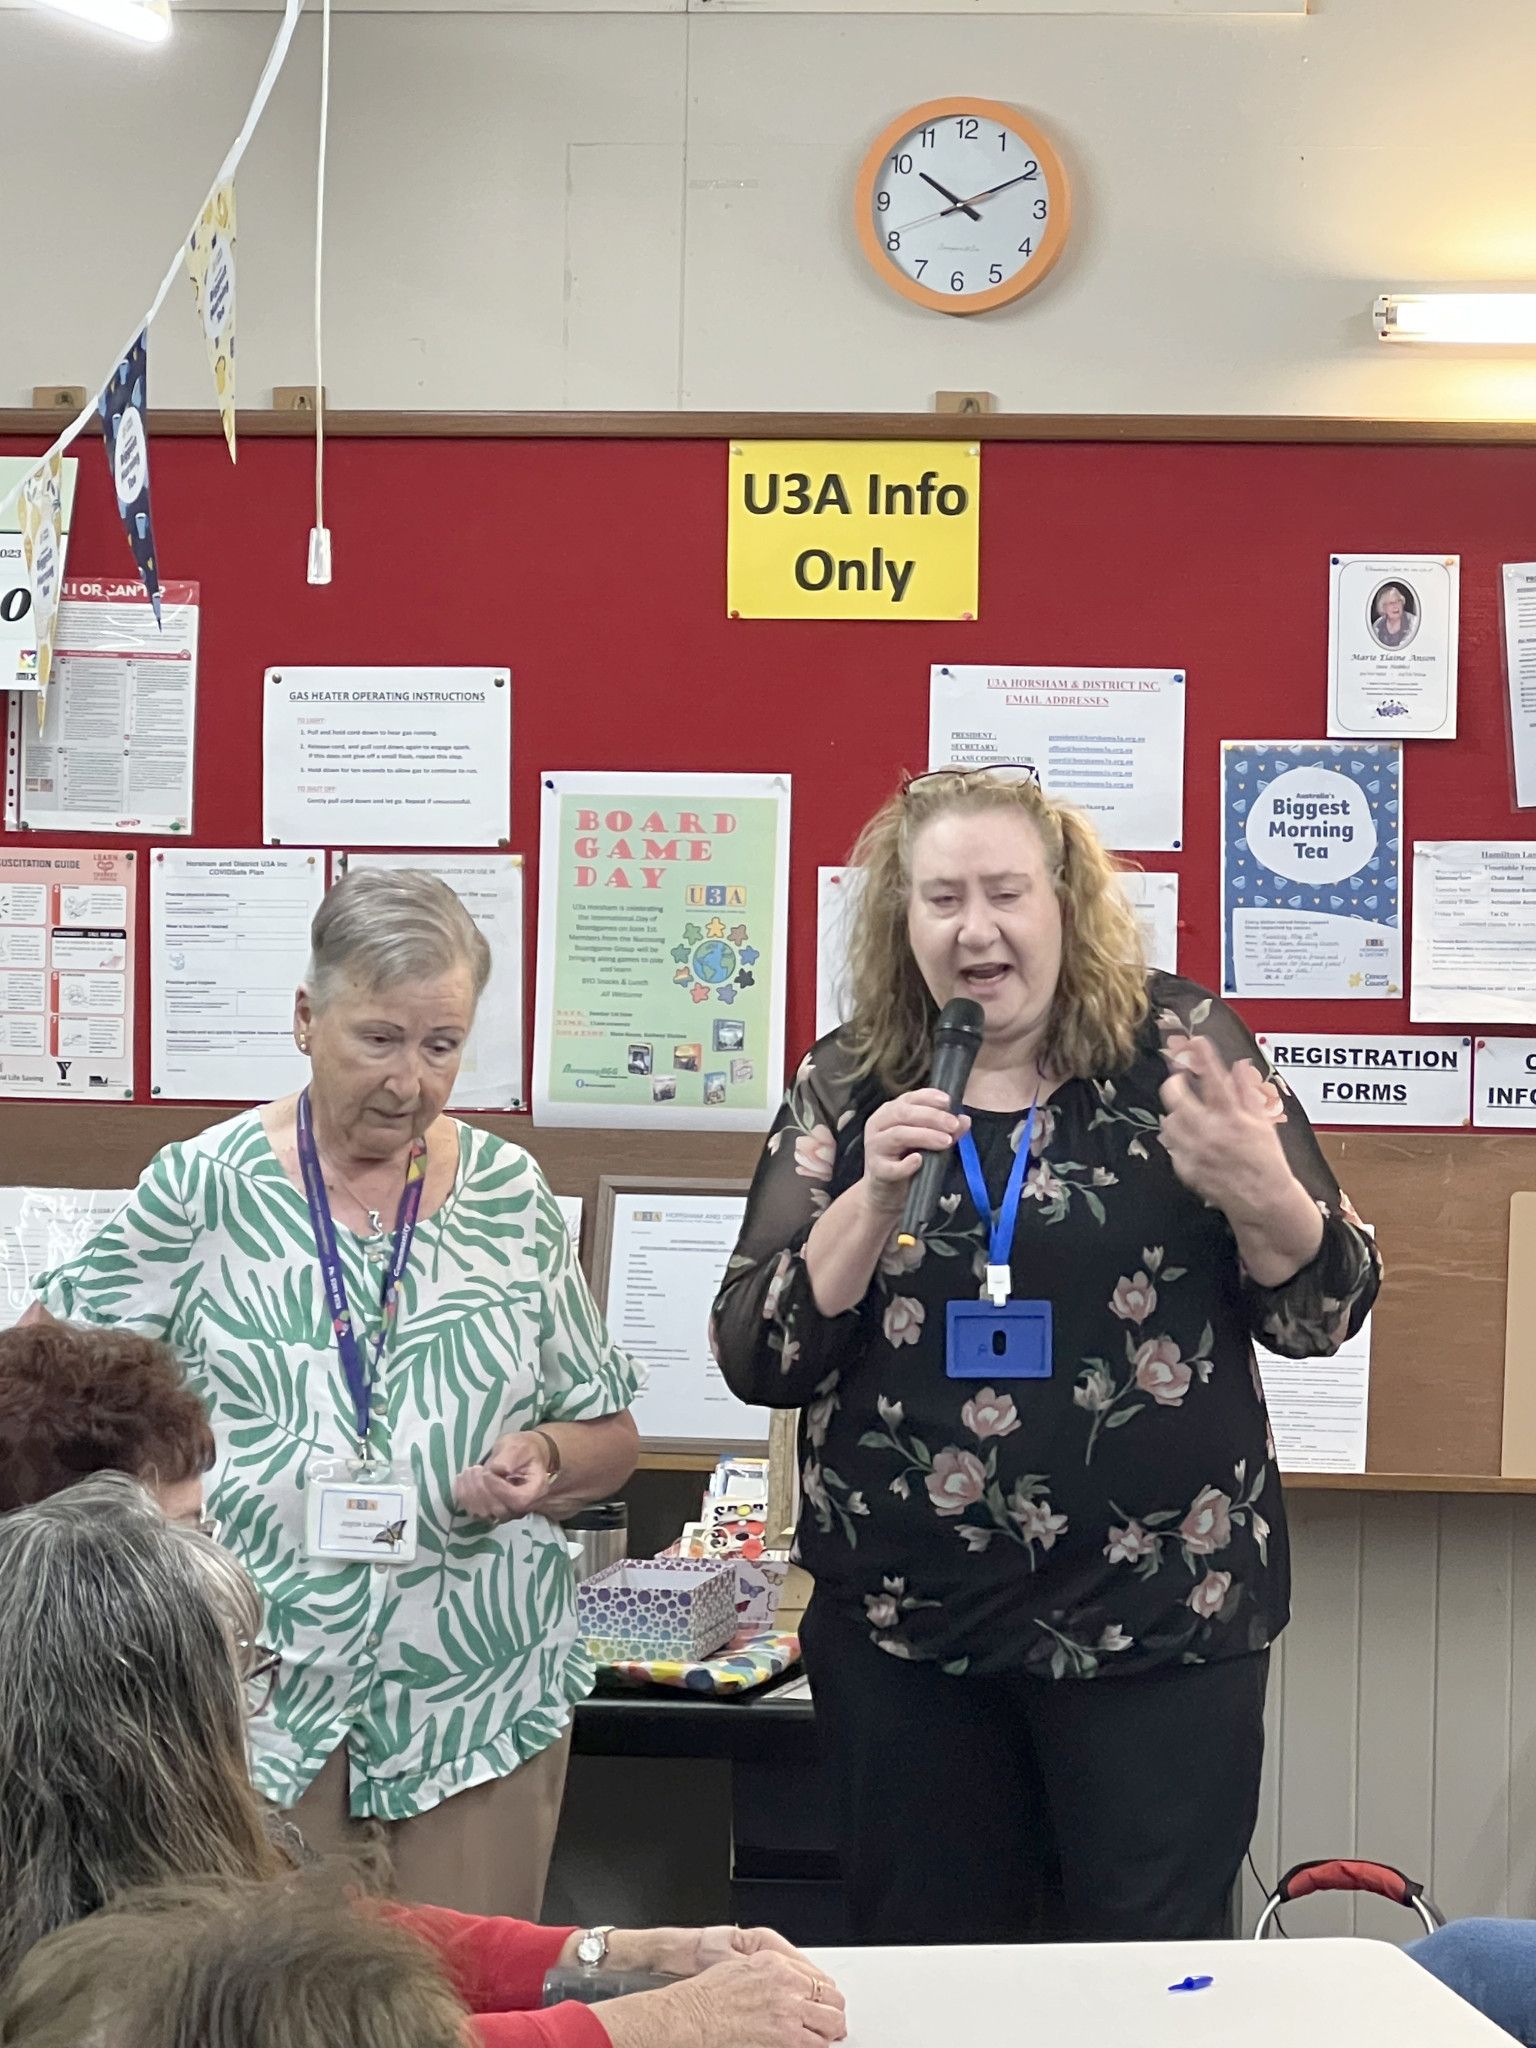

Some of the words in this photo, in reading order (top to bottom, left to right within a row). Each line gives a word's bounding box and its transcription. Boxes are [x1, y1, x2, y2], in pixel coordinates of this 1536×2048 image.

[918, 128, 936, 148] 11
[956, 119, 979, 139] 12
[998, 132, 1006, 152] 1
[891, 154, 913, 174] 10
[1023, 160, 1038, 181] 2
[877, 191, 890, 211] 9
[1033, 199, 1047, 219] 3
[887, 231, 900, 251] 8
[1017, 237, 1032, 257] 4
[915, 259, 928, 279] 7
[988, 264, 1003, 284] 5
[950, 271, 964, 291] 6
[744, 472, 852, 515] U3A
[868, 471, 968, 516] Info
[795, 547, 916, 602] Only
[80, 584, 103, 597] OR
[987, 678, 1008, 688] U3A
[1011, 679, 1068, 689] HORSHAM
[1071, 679, 1080, 689] &
[1082, 680, 1136, 690] DISTRICT
[1138, 681, 1161, 691] INC.
[289, 691, 309, 701] GAS
[311, 691, 350, 701] HEATER
[352, 691, 410, 701] OPERATING
[412, 692, 485, 702] INSTRUCTIONS
[1006, 695, 1040, 705] EMAIL
[1046, 696, 1109, 706] ADDRESSES
[1295, 792, 1336, 800] Australia's
[1273, 797, 1351, 820] Biggest
[574, 809, 737, 834] BOARD
[1269, 821, 1354, 843] Morning
[573, 836, 713, 862] GAME
[1293, 842, 1329, 859] Tea
[1481, 851, 1520, 859] Hamilton
[0, 857, 51, 869] USCITATION
[54, 858, 81, 870] GUIDE
[573, 865, 668, 889] DAY
[689, 886, 743, 906] U3A
[1364, 979, 1390, 987] Council
[1273, 1046, 1458, 1068] REGISTRATION
[1322, 1082, 1408, 1101] FORMS
